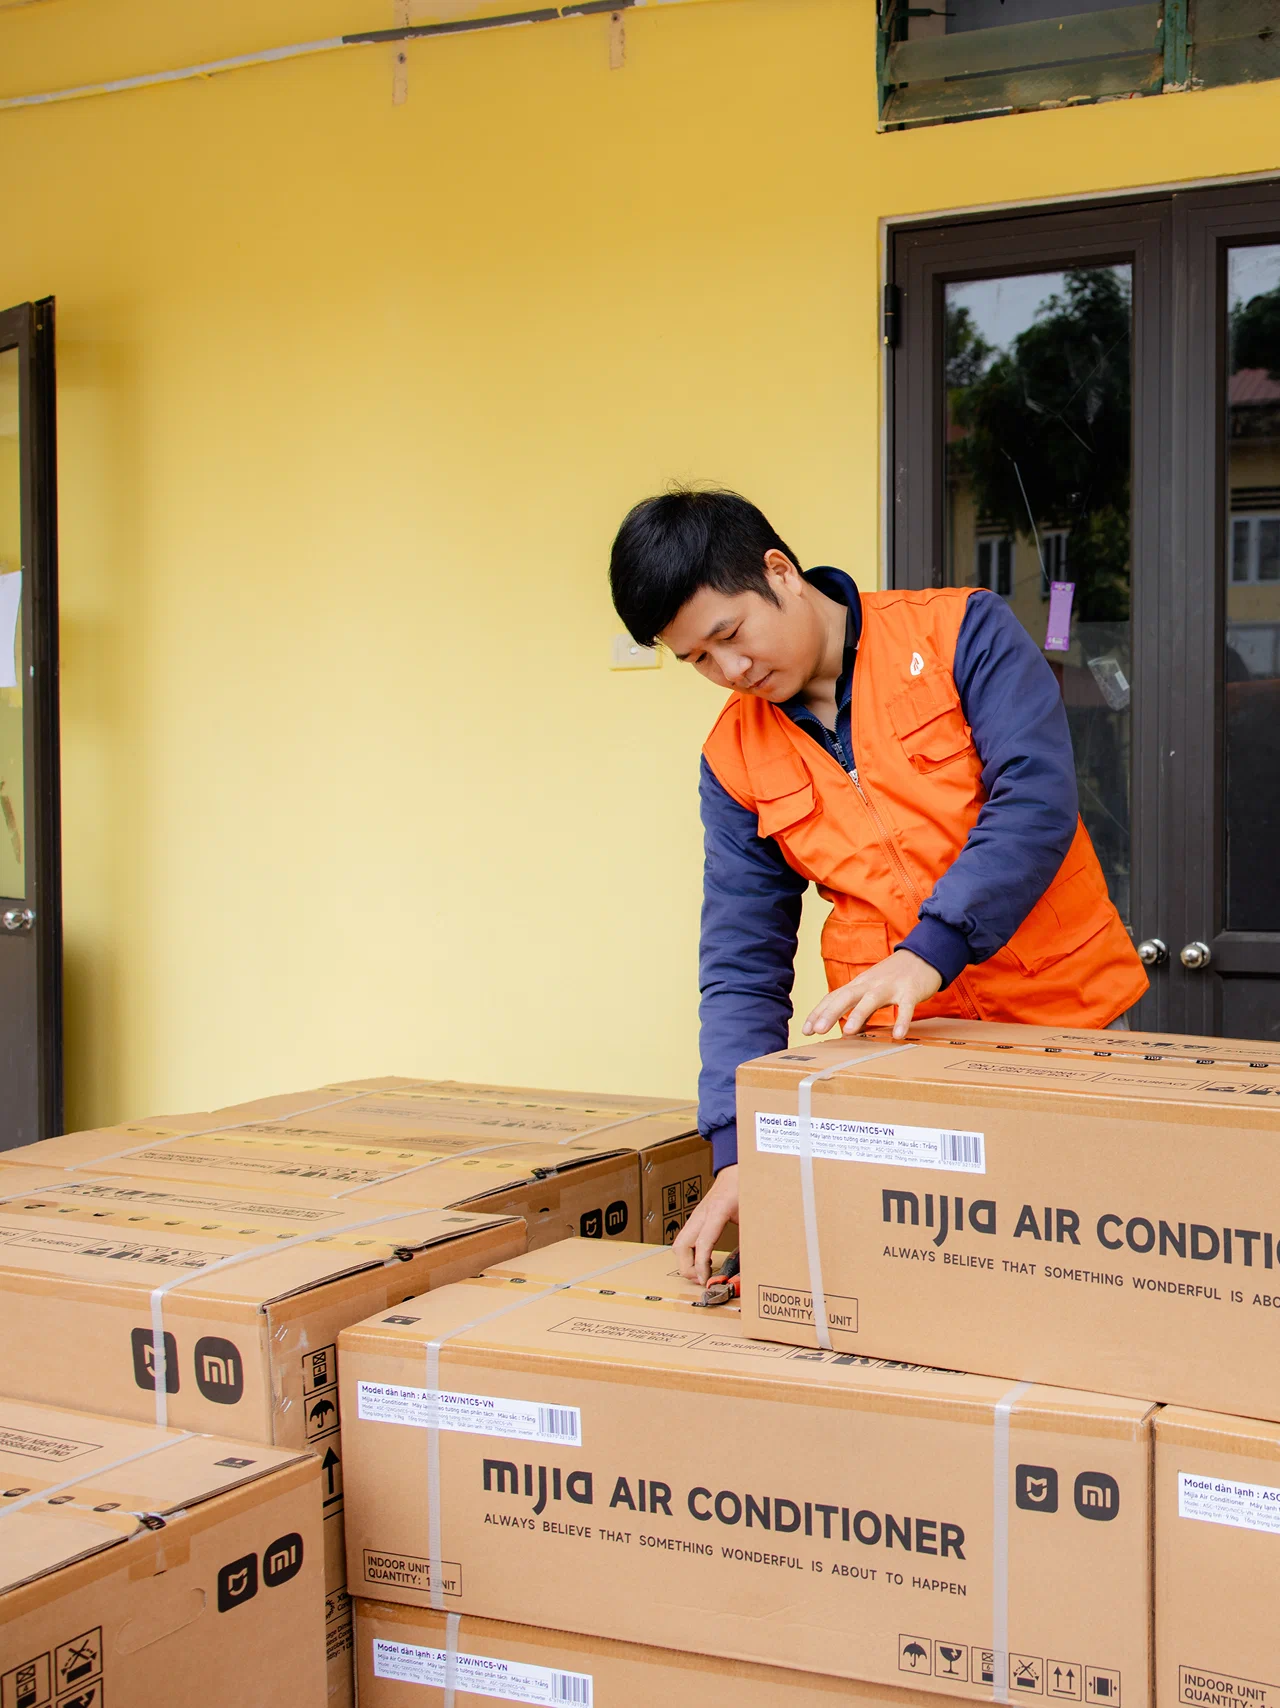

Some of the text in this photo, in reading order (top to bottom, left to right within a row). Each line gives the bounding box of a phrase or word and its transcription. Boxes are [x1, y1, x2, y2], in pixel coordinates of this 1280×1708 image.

[759, 1116, 782, 1126] Model
[783, 1118, 797, 1127] dàn
[819, 1122, 895, 1136] ASC-12W/N1C5-VN
[779, 1129, 800, 1137] Conditio
[882, 1189, 996, 1246] mijia
[1013, 1205, 1081, 1245] AIR
[883, 1246, 936, 1262] ALWAYS
[943, 1253, 993, 1269] BELIEVE
[1002, 1261, 1036, 1275] THAT
[1045, 1266, 1123, 1286] SOMETHING
[1133, 1277, 1221, 1300] WONDERFUL
[1232, 1291, 1243, 1302] IS
[763, 1292, 801, 1306] INDOOR
[829, 1314, 852, 1327] UNIT
[595, 1328, 624, 1336] OPEN
[603, 1324, 688, 1339] PROFESSIONALS
[732, 1342, 781, 1352] SURFACE
[361, 1385, 384, 1395] Model
[385, 1387, 399, 1398] dàn
[400, 1390, 416, 1400] lạnh
[1184, 1478, 1213, 1490] Model
[1214, 1481, 1232, 1494] dàn
[1234, 1485, 1254, 1497] lạnh
[1184, 1490, 1198, 1499] Mijia
[1199, 1492, 1208, 1500] Air
[1209, 1494, 1245, 1506] Conditioner
[483, 1459, 966, 1558] mijia AIR CONDITIONER
[485, 1513, 966, 1595] ALWAYS BELIEVE THAT SOMETHING WONDERFUL IS ABOUT TO HAPPEN
[368, 1556, 430, 1575] INDOOR UNIT
[368, 1568, 421, 1585] QUANTITY:
[377, 1643, 399, 1654] Model
[436, 1653, 509, 1672] AS12W/N1C5-VN
[1184, 1674, 1267, 1701] INDOOR UNIT
